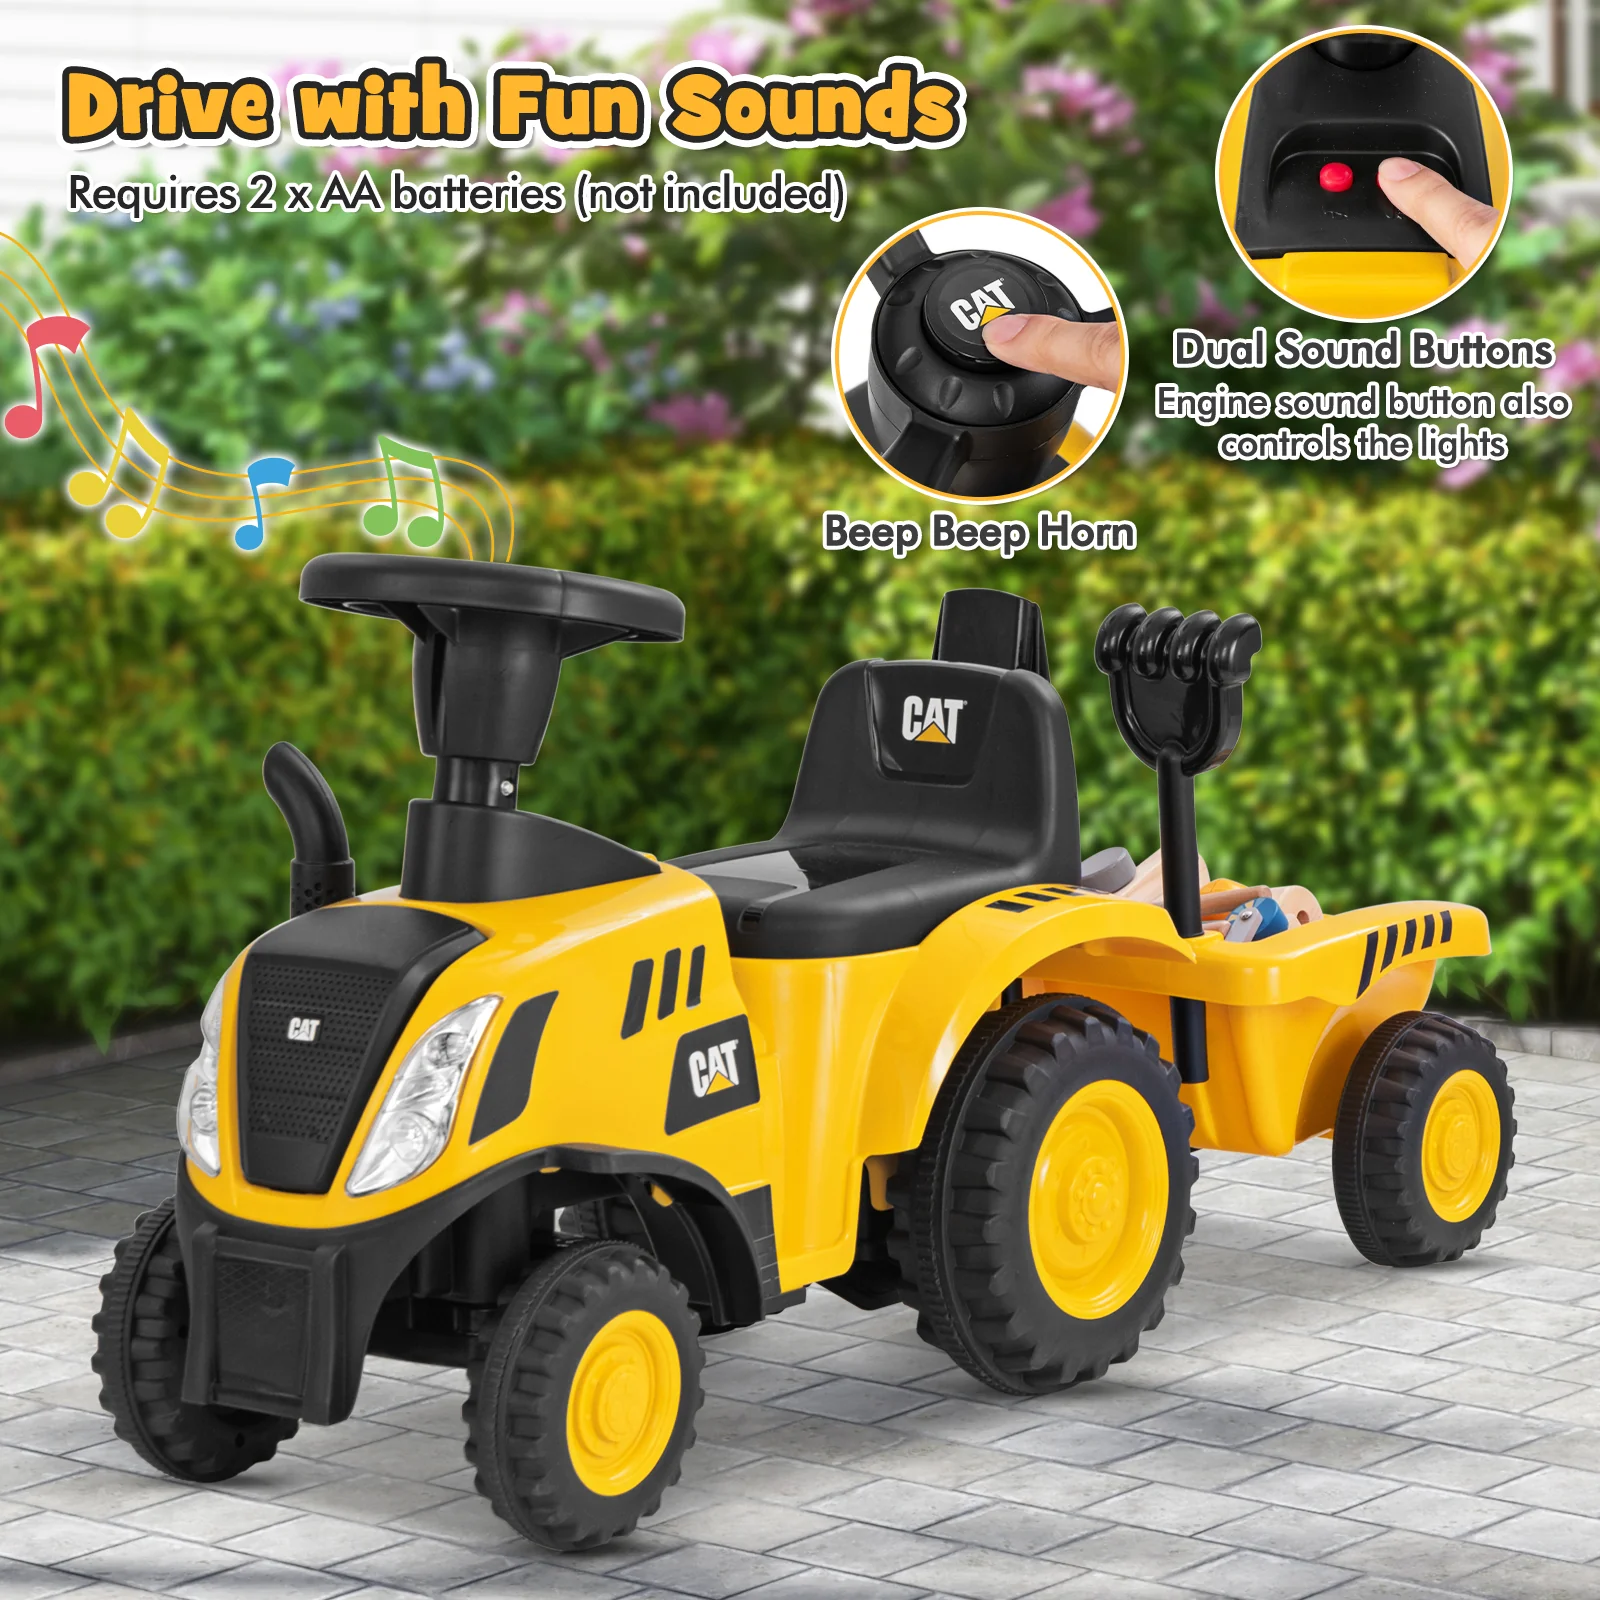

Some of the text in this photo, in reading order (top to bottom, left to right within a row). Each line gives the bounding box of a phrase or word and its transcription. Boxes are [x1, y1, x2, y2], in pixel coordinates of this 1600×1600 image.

[950, 278, 1015, 331] CAT
[902, 695, 964, 744] CAT
[288, 1017, 320, 1041] CAT
[688, 1039, 739, 1098] CAT
